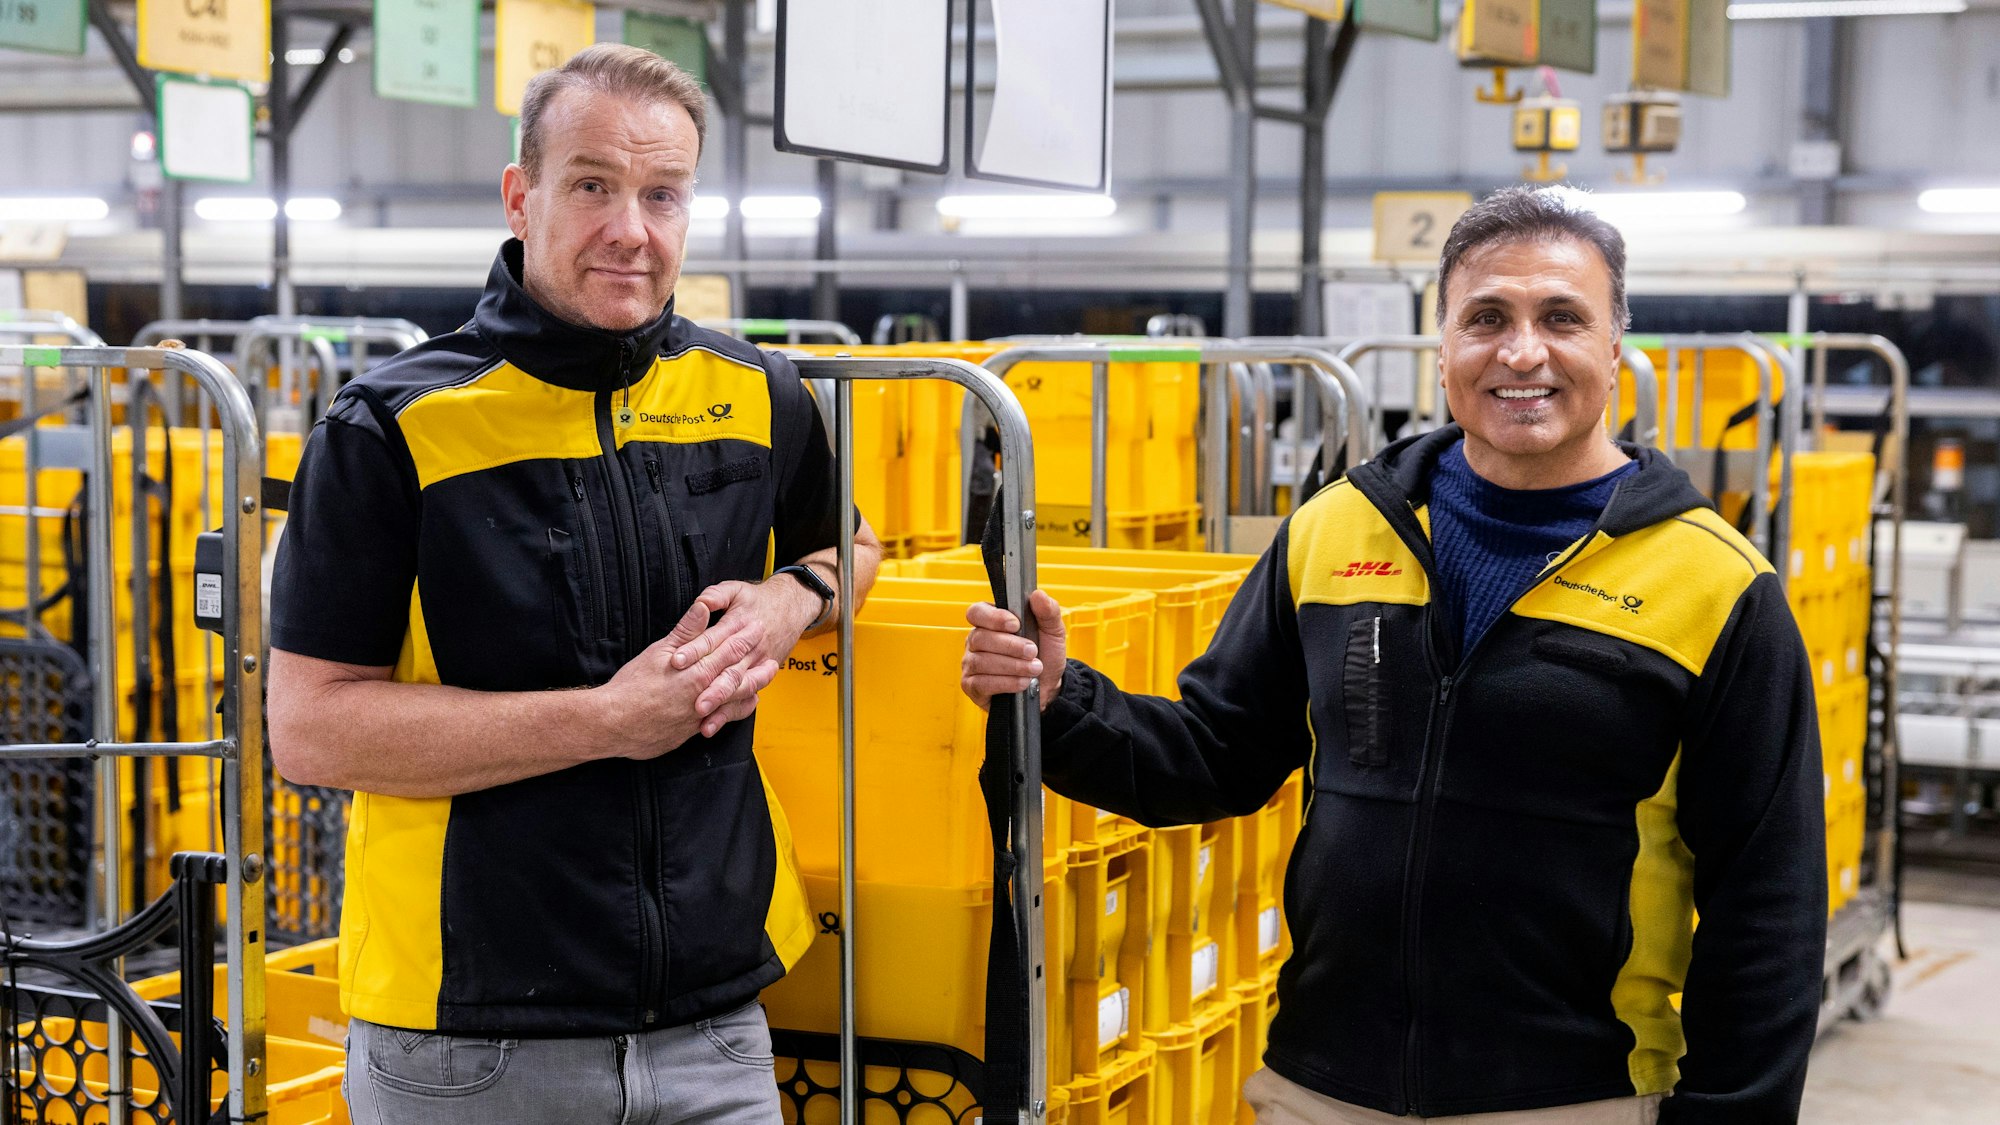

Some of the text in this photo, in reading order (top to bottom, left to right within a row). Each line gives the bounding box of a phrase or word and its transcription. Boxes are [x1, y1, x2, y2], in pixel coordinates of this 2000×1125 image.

[1411, 211, 1435, 247] 2
[640, 412, 706, 424] Deutsche Post
[1341, 561, 1396, 577] DHL
[1554, 575, 1618, 602] Deutsche Post
[788, 657, 817, 672] Post
